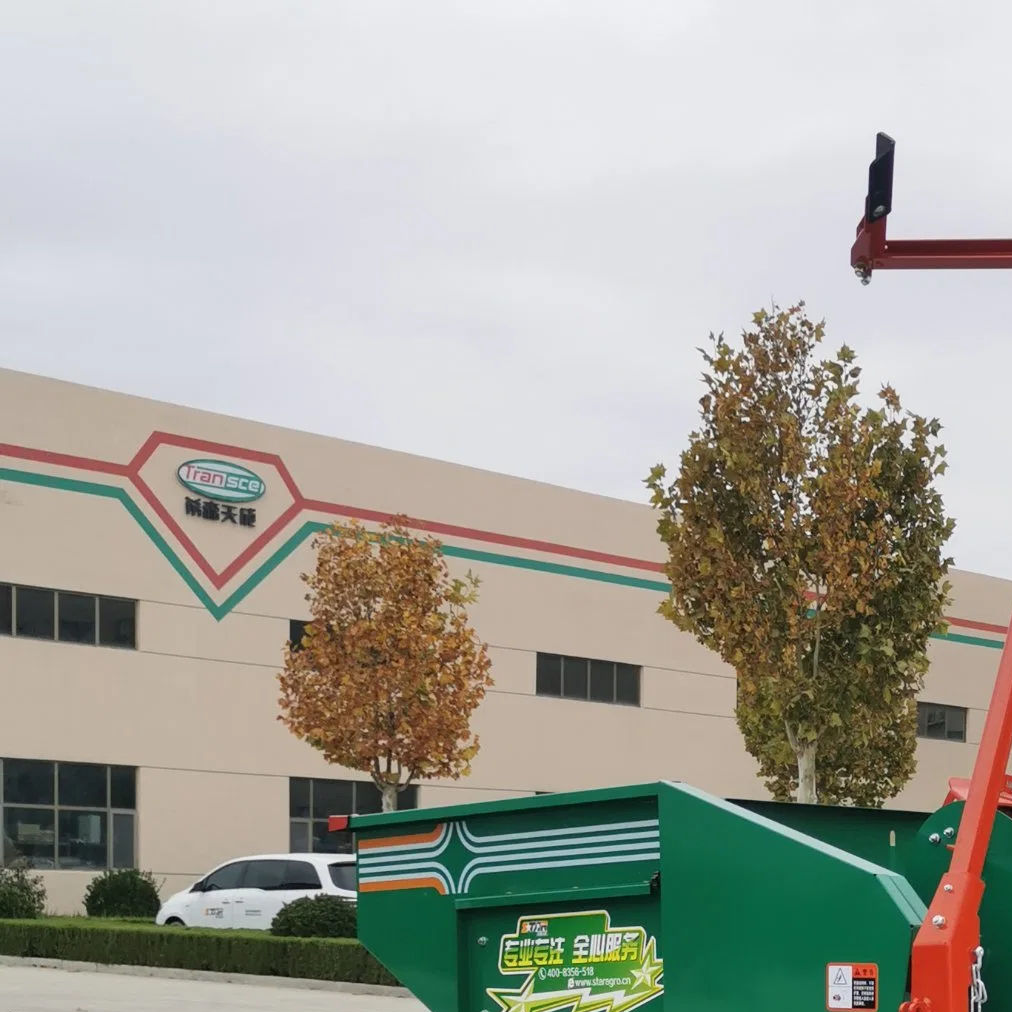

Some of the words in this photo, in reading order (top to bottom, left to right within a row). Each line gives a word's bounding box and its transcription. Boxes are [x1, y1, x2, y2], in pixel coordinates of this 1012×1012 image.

[185, 465, 260, 492] Transce
[504, 937, 565, 967] 专业专注
[572, 932, 640, 964] 全心服务
[547, 966, 594, 978] 400-8356-518
[575, 976, 631, 988] www.staragro.cn
